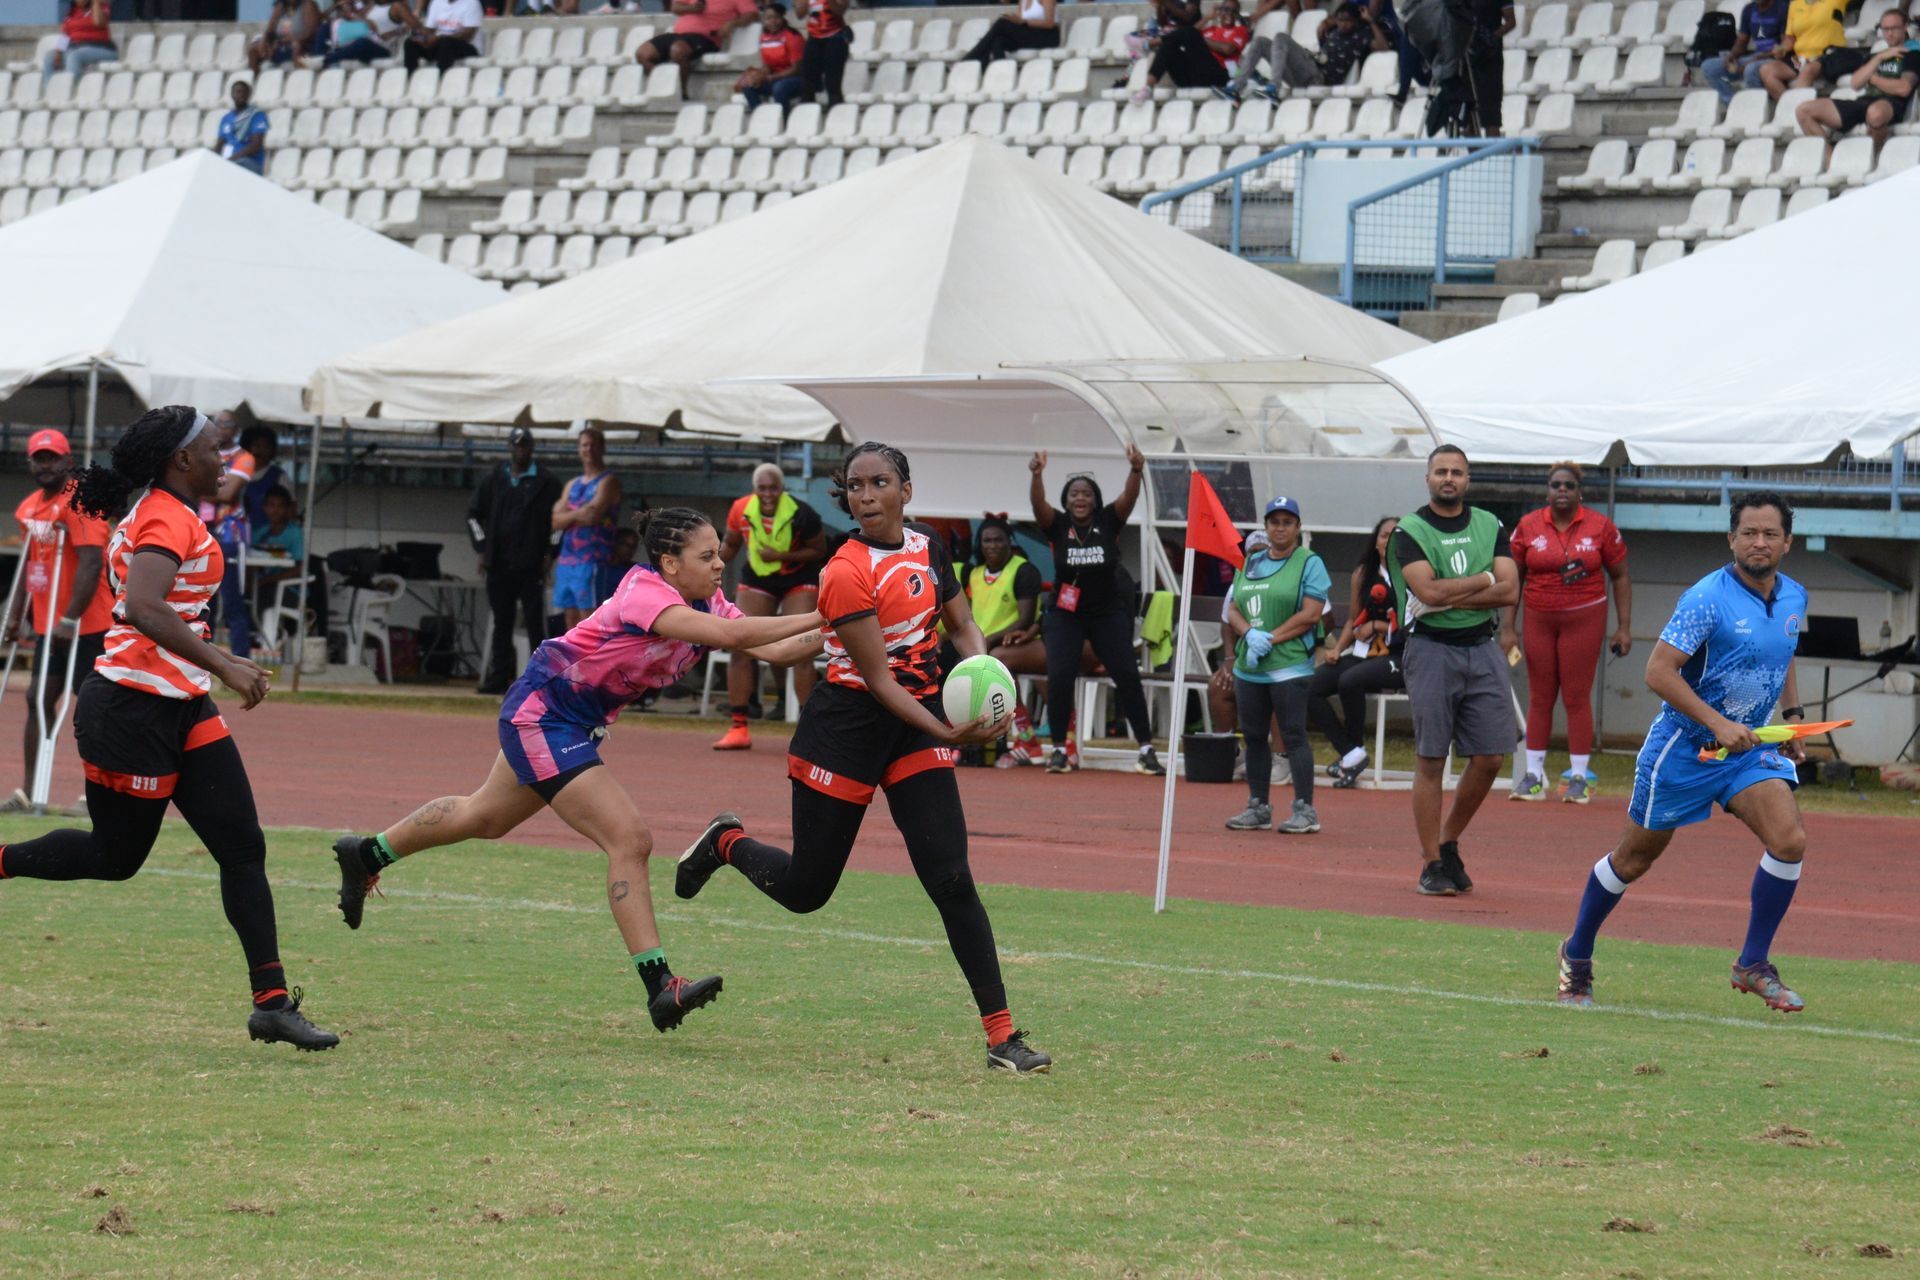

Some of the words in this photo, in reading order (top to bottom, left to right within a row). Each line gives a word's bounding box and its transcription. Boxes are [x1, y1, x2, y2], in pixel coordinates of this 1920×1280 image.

[1067, 546, 1104, 557] TRINIDAD
[991, 692, 1005, 726] GIL
[132, 775, 158, 791] U19
[809, 765, 833, 786] U19
